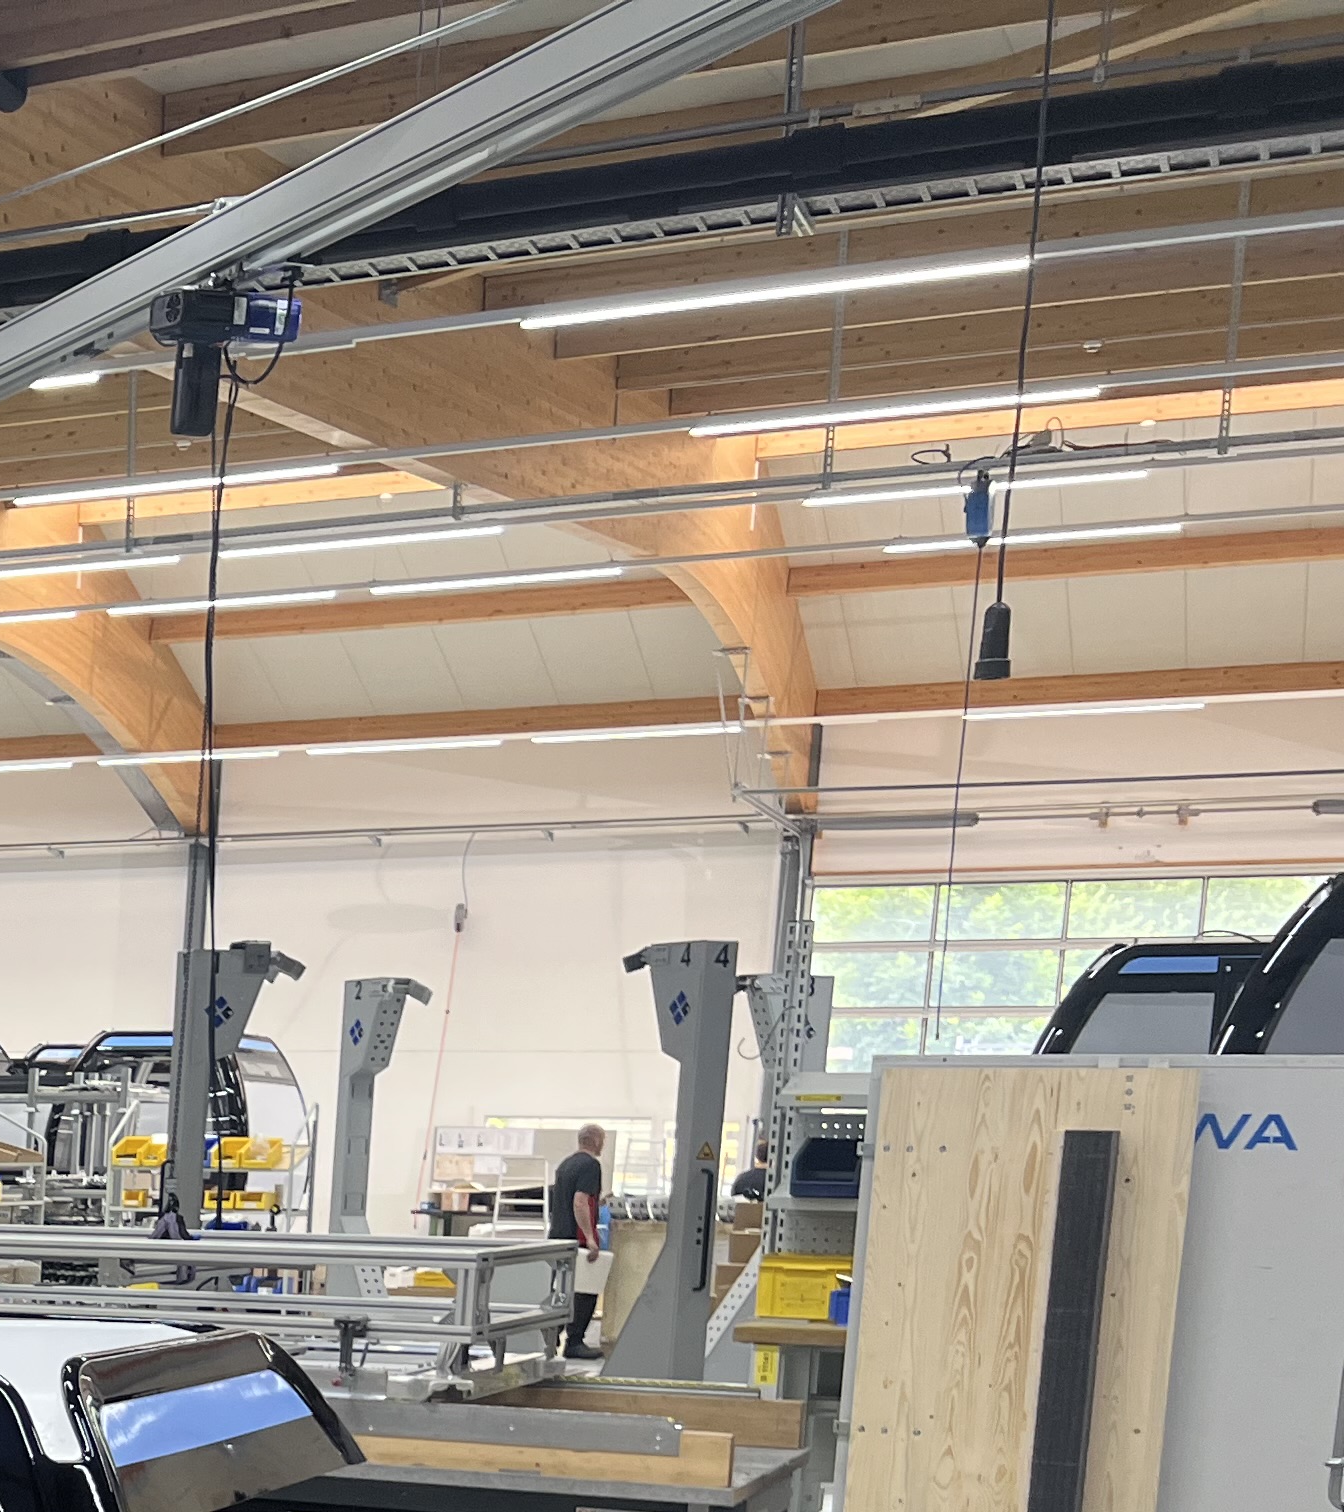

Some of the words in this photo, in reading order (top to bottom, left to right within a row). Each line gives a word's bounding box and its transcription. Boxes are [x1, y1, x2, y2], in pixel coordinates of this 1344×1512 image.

[680, 943, 692, 968] 4
[714, 943, 730, 968] 4
[355, 980, 363, 1000] 2
